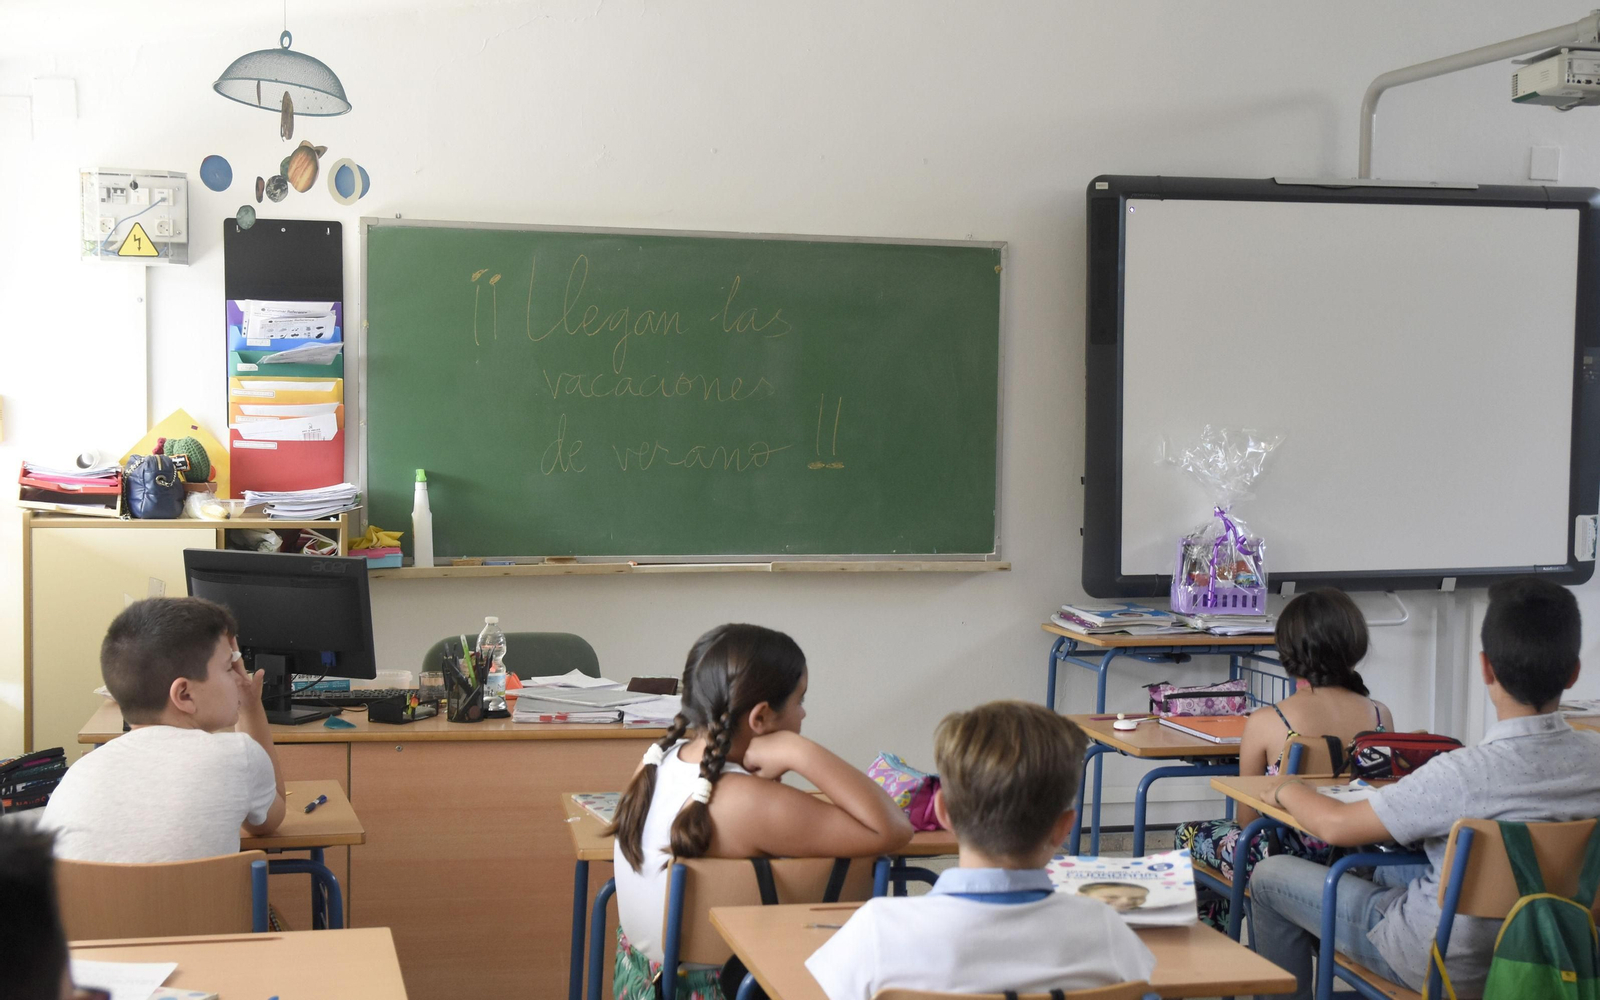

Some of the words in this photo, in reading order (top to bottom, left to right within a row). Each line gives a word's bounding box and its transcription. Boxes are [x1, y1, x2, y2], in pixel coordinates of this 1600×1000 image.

[526, 254, 690, 375] Llegan
[709, 275, 792, 338] las
[542, 369, 775, 402] vacaciones
[540, 413, 587, 476] de
[612, 441, 793, 472] verano
[311, 560, 352, 573] acer
